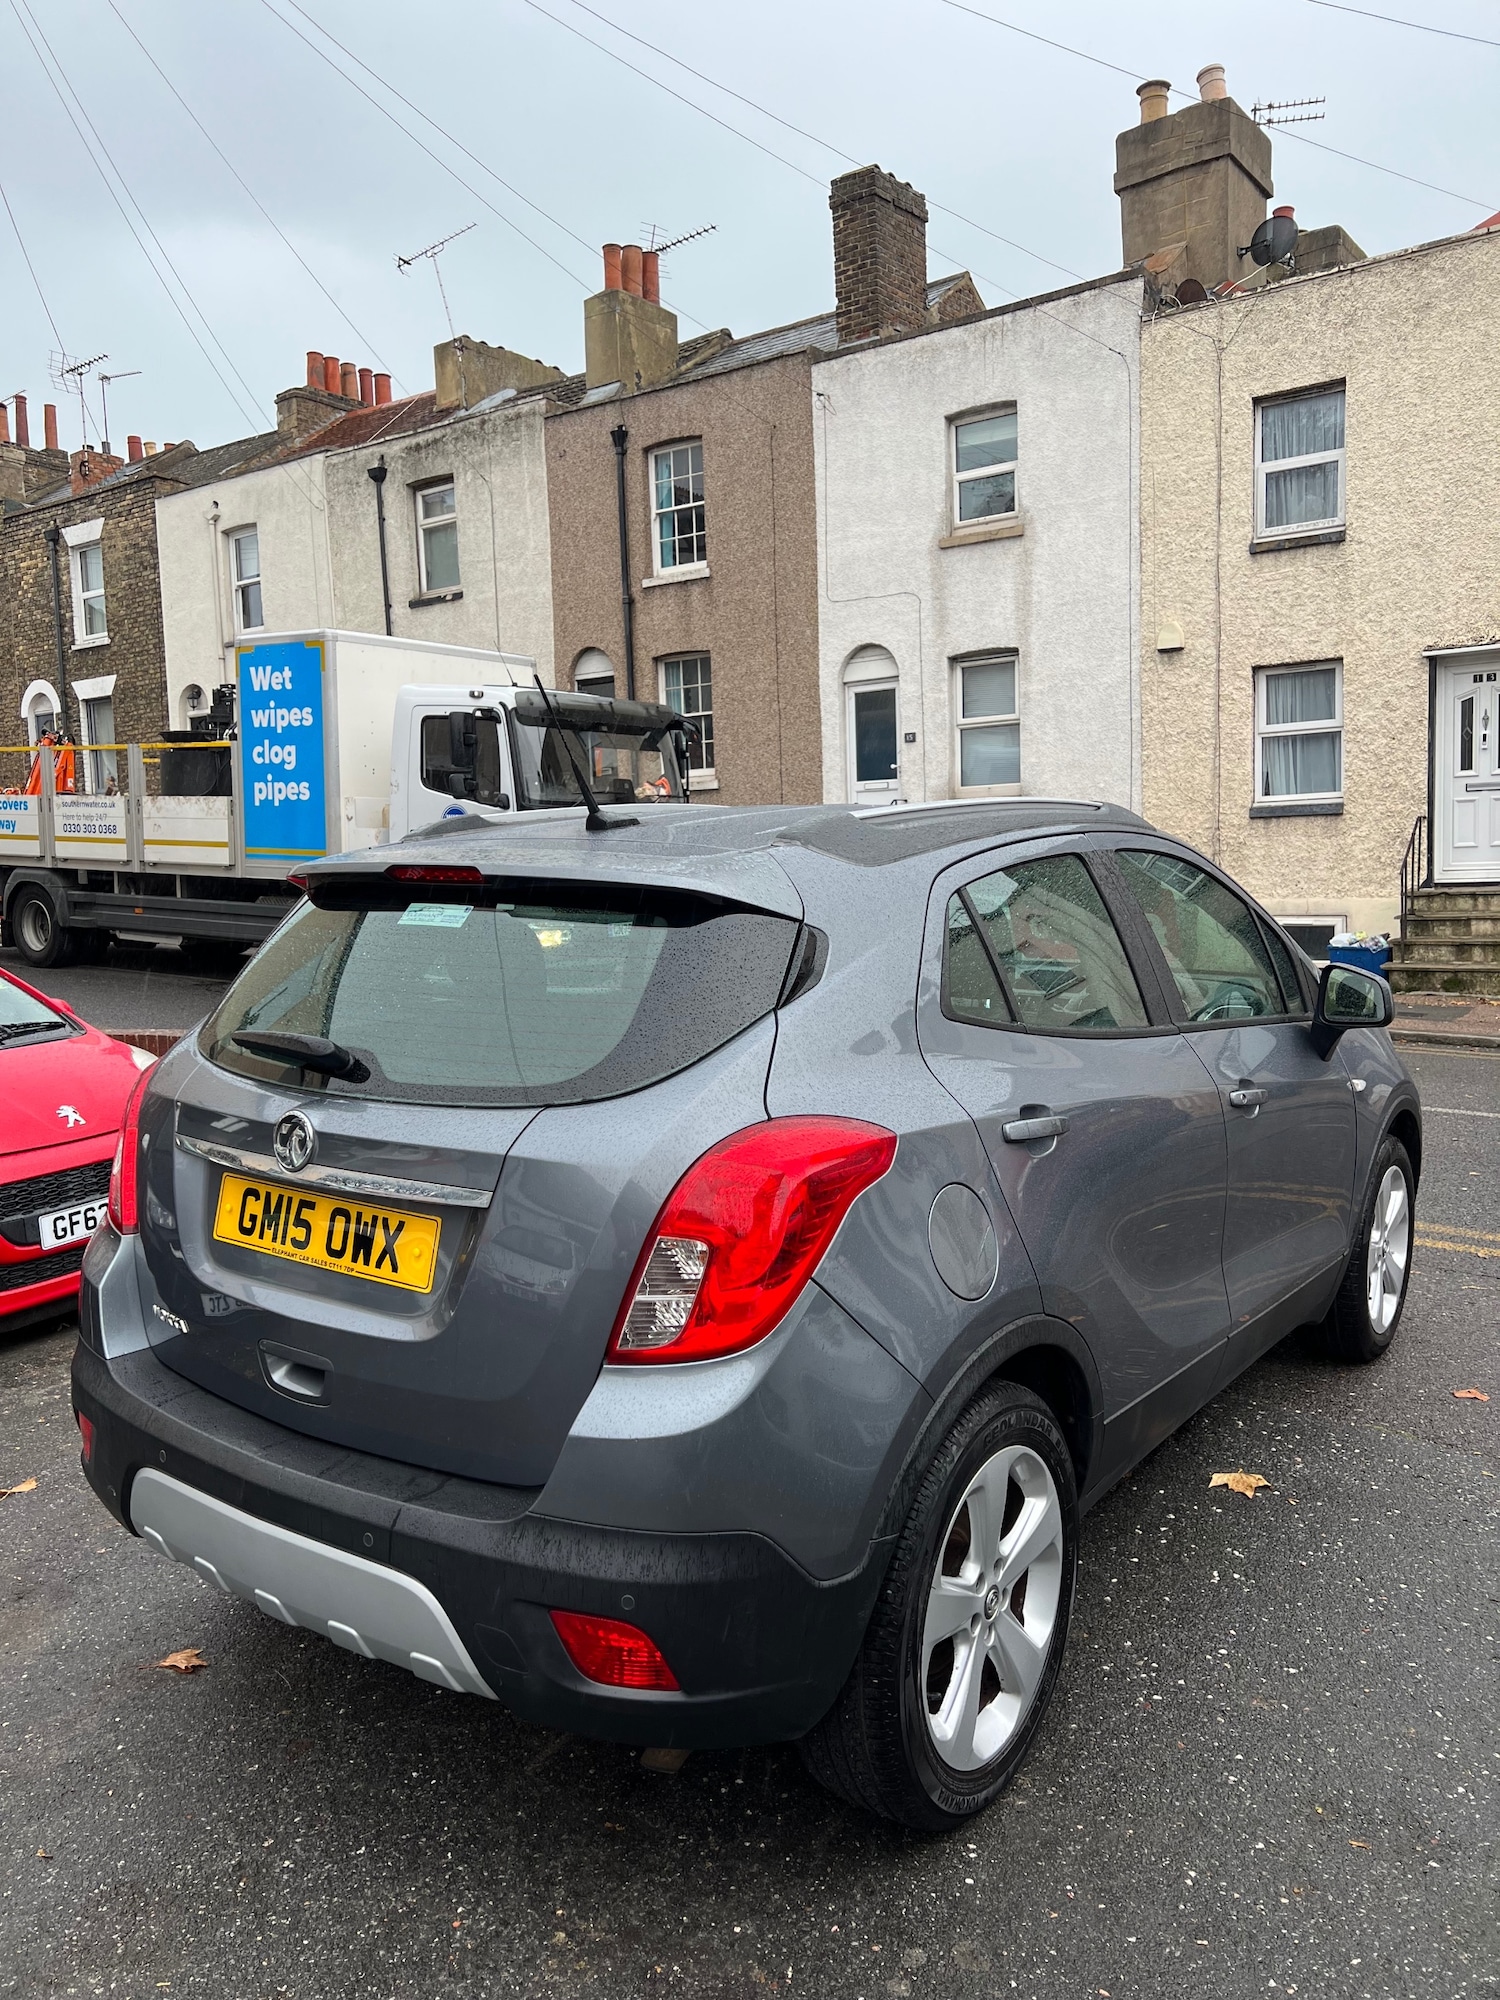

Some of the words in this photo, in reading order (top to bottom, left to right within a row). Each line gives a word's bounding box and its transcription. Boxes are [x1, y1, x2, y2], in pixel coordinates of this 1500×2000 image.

[249, 665, 292, 691] Wet
[251, 700, 313, 733] wipes
[252, 739, 296, 770] clog
[254, 773, 311, 806] pipes
[61, 800, 116, 808] southernwater.co.uk
[82, 814, 94, 822] help
[63, 823, 81, 833] 0330
[83, 824, 97, 834] 303
[98, 824, 117, 834] 0368
[53, 1202, 109, 1240] GF6
[238, 1187, 316, 1251] GM15
[325, 1206, 405, 1274] OWX
[271, 1247, 298, 1259] ELEPHANT
[298, 1254, 310, 1262] CAR
[310, 1257, 328, 1267] SALES
[328, 1262, 342, 1271] CT11
